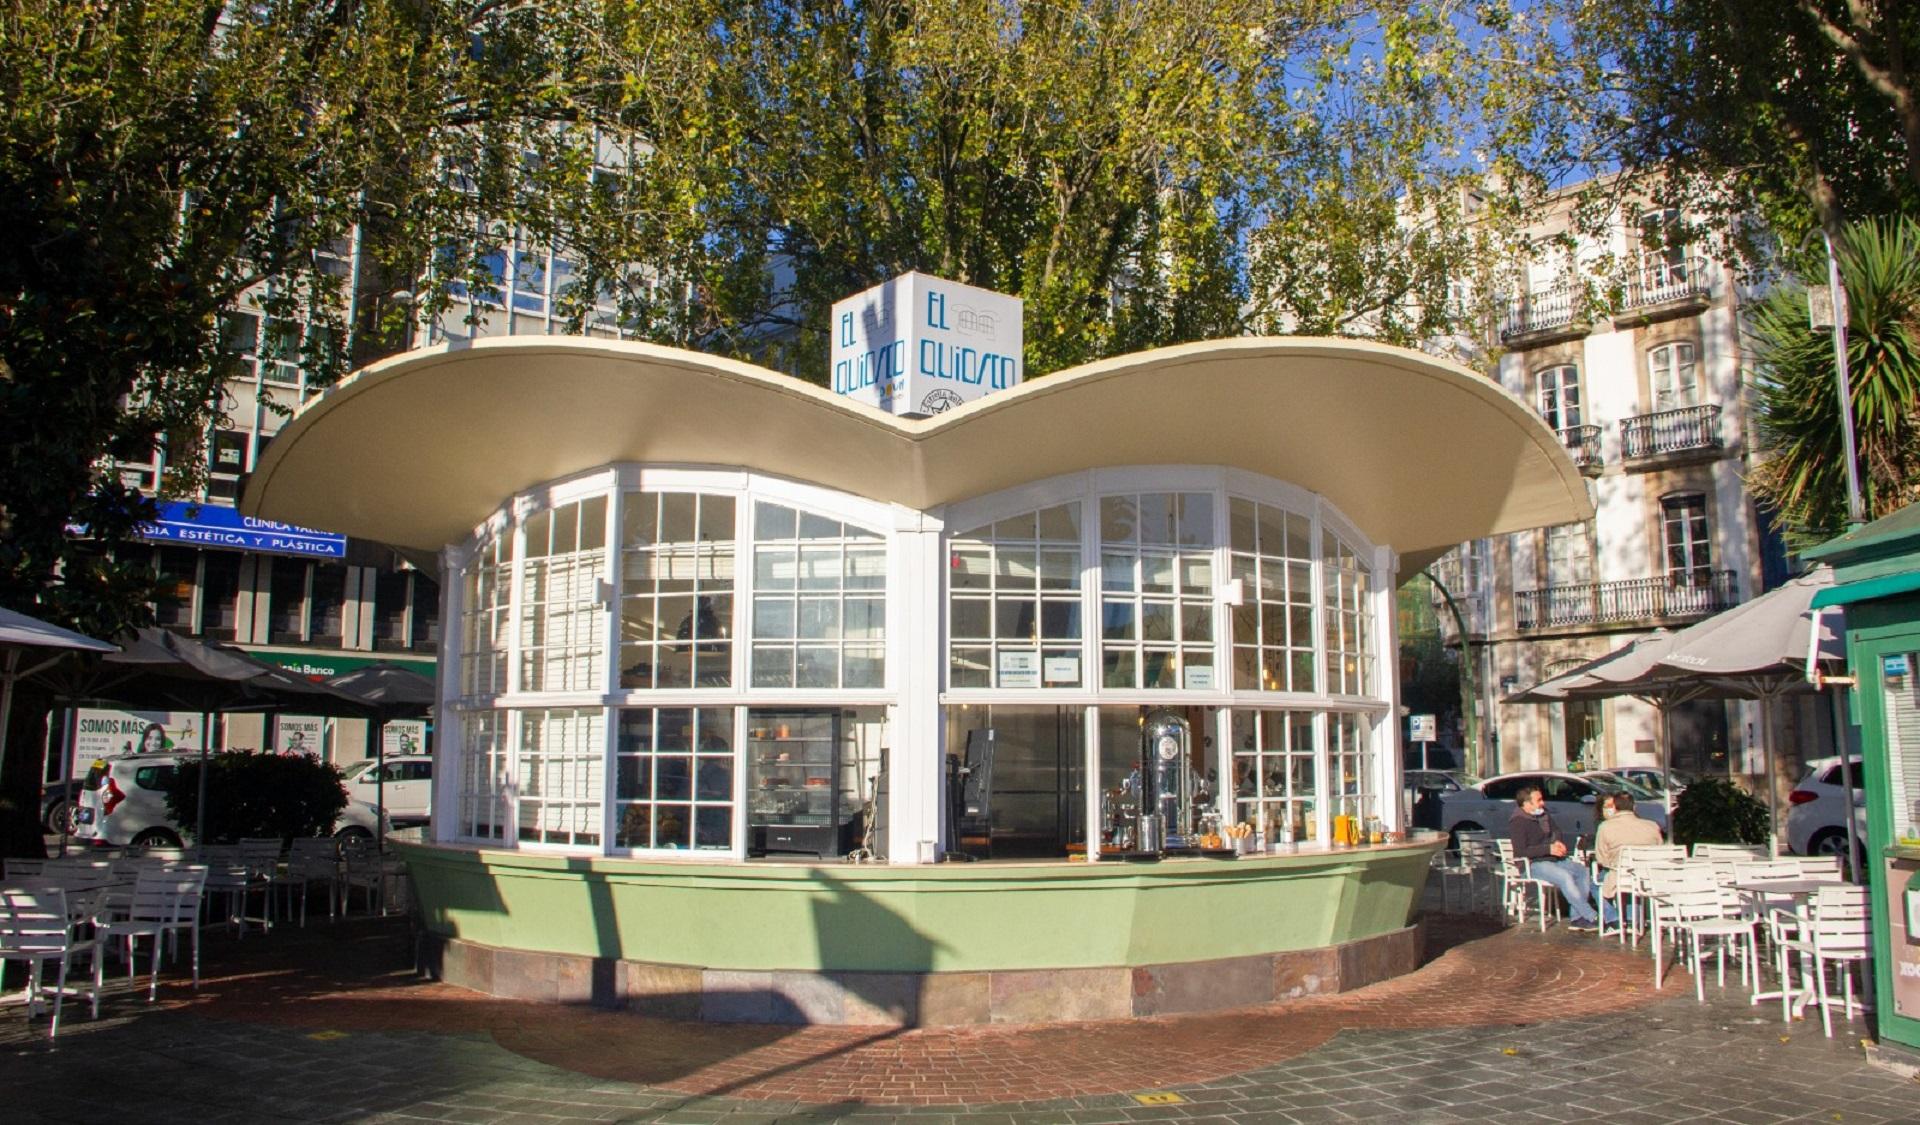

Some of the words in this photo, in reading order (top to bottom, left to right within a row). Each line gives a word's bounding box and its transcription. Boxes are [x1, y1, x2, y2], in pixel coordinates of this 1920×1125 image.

[928, 291, 950, 330] EL
[841, 312, 856, 348] EL
[179, 530, 246, 545] ESTÉTICA
[255, 537, 264, 547] Y
[272, 538, 336, 553] PLÁSTICA
[303, 664, 335, 675] Banco
[80, 718, 119, 734] SOMOS
